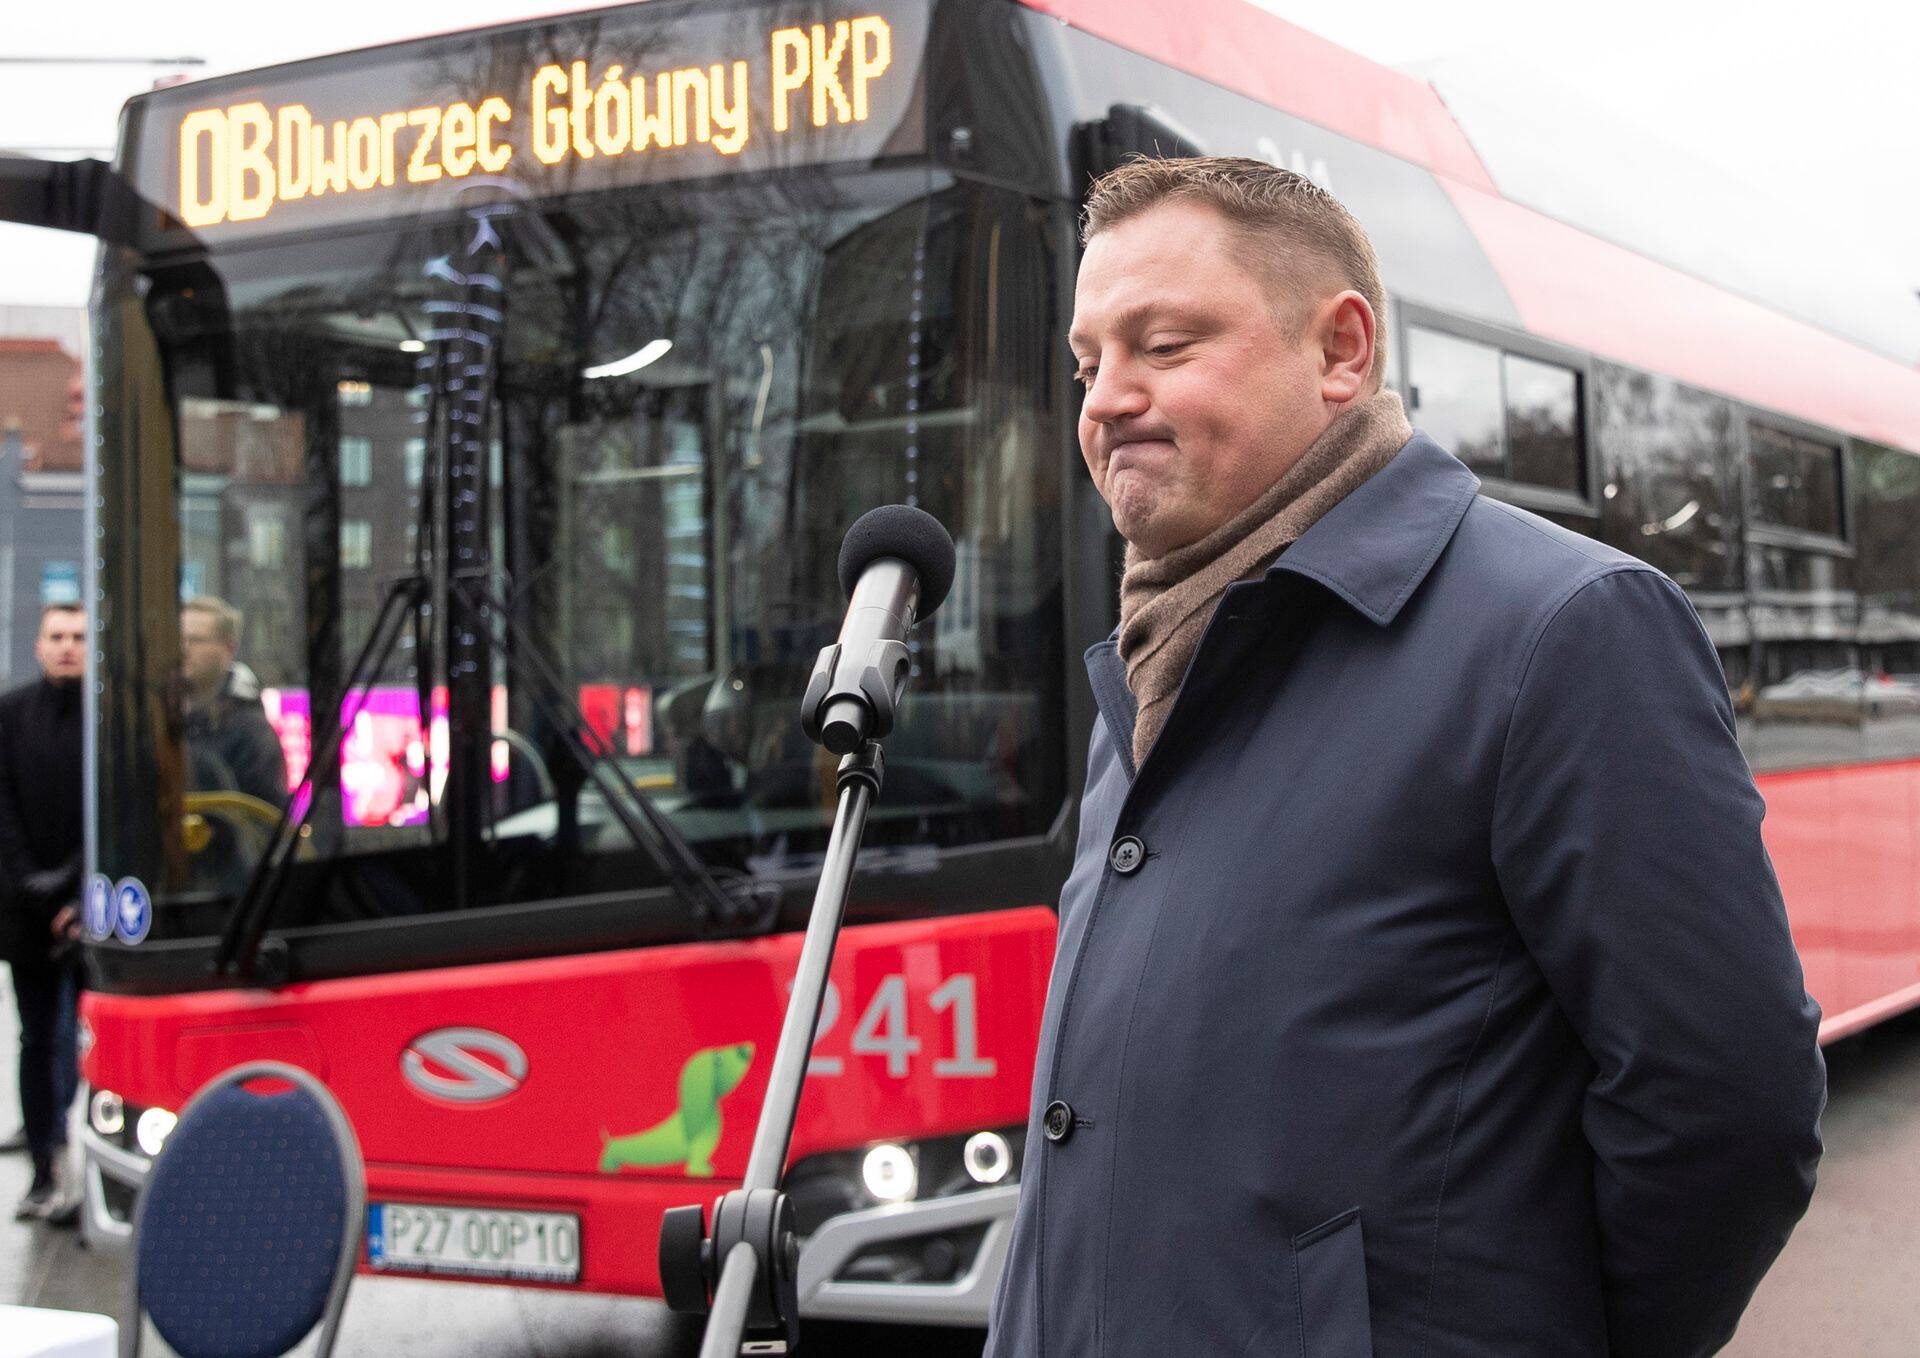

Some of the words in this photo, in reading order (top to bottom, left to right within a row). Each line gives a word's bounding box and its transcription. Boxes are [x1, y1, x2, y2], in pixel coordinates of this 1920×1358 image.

[278, 96, 512, 201] Dworzec
[531, 60, 749, 165] Główny
[771, 15, 892, 133] PKP
[787, 974, 998, 1077] 241
